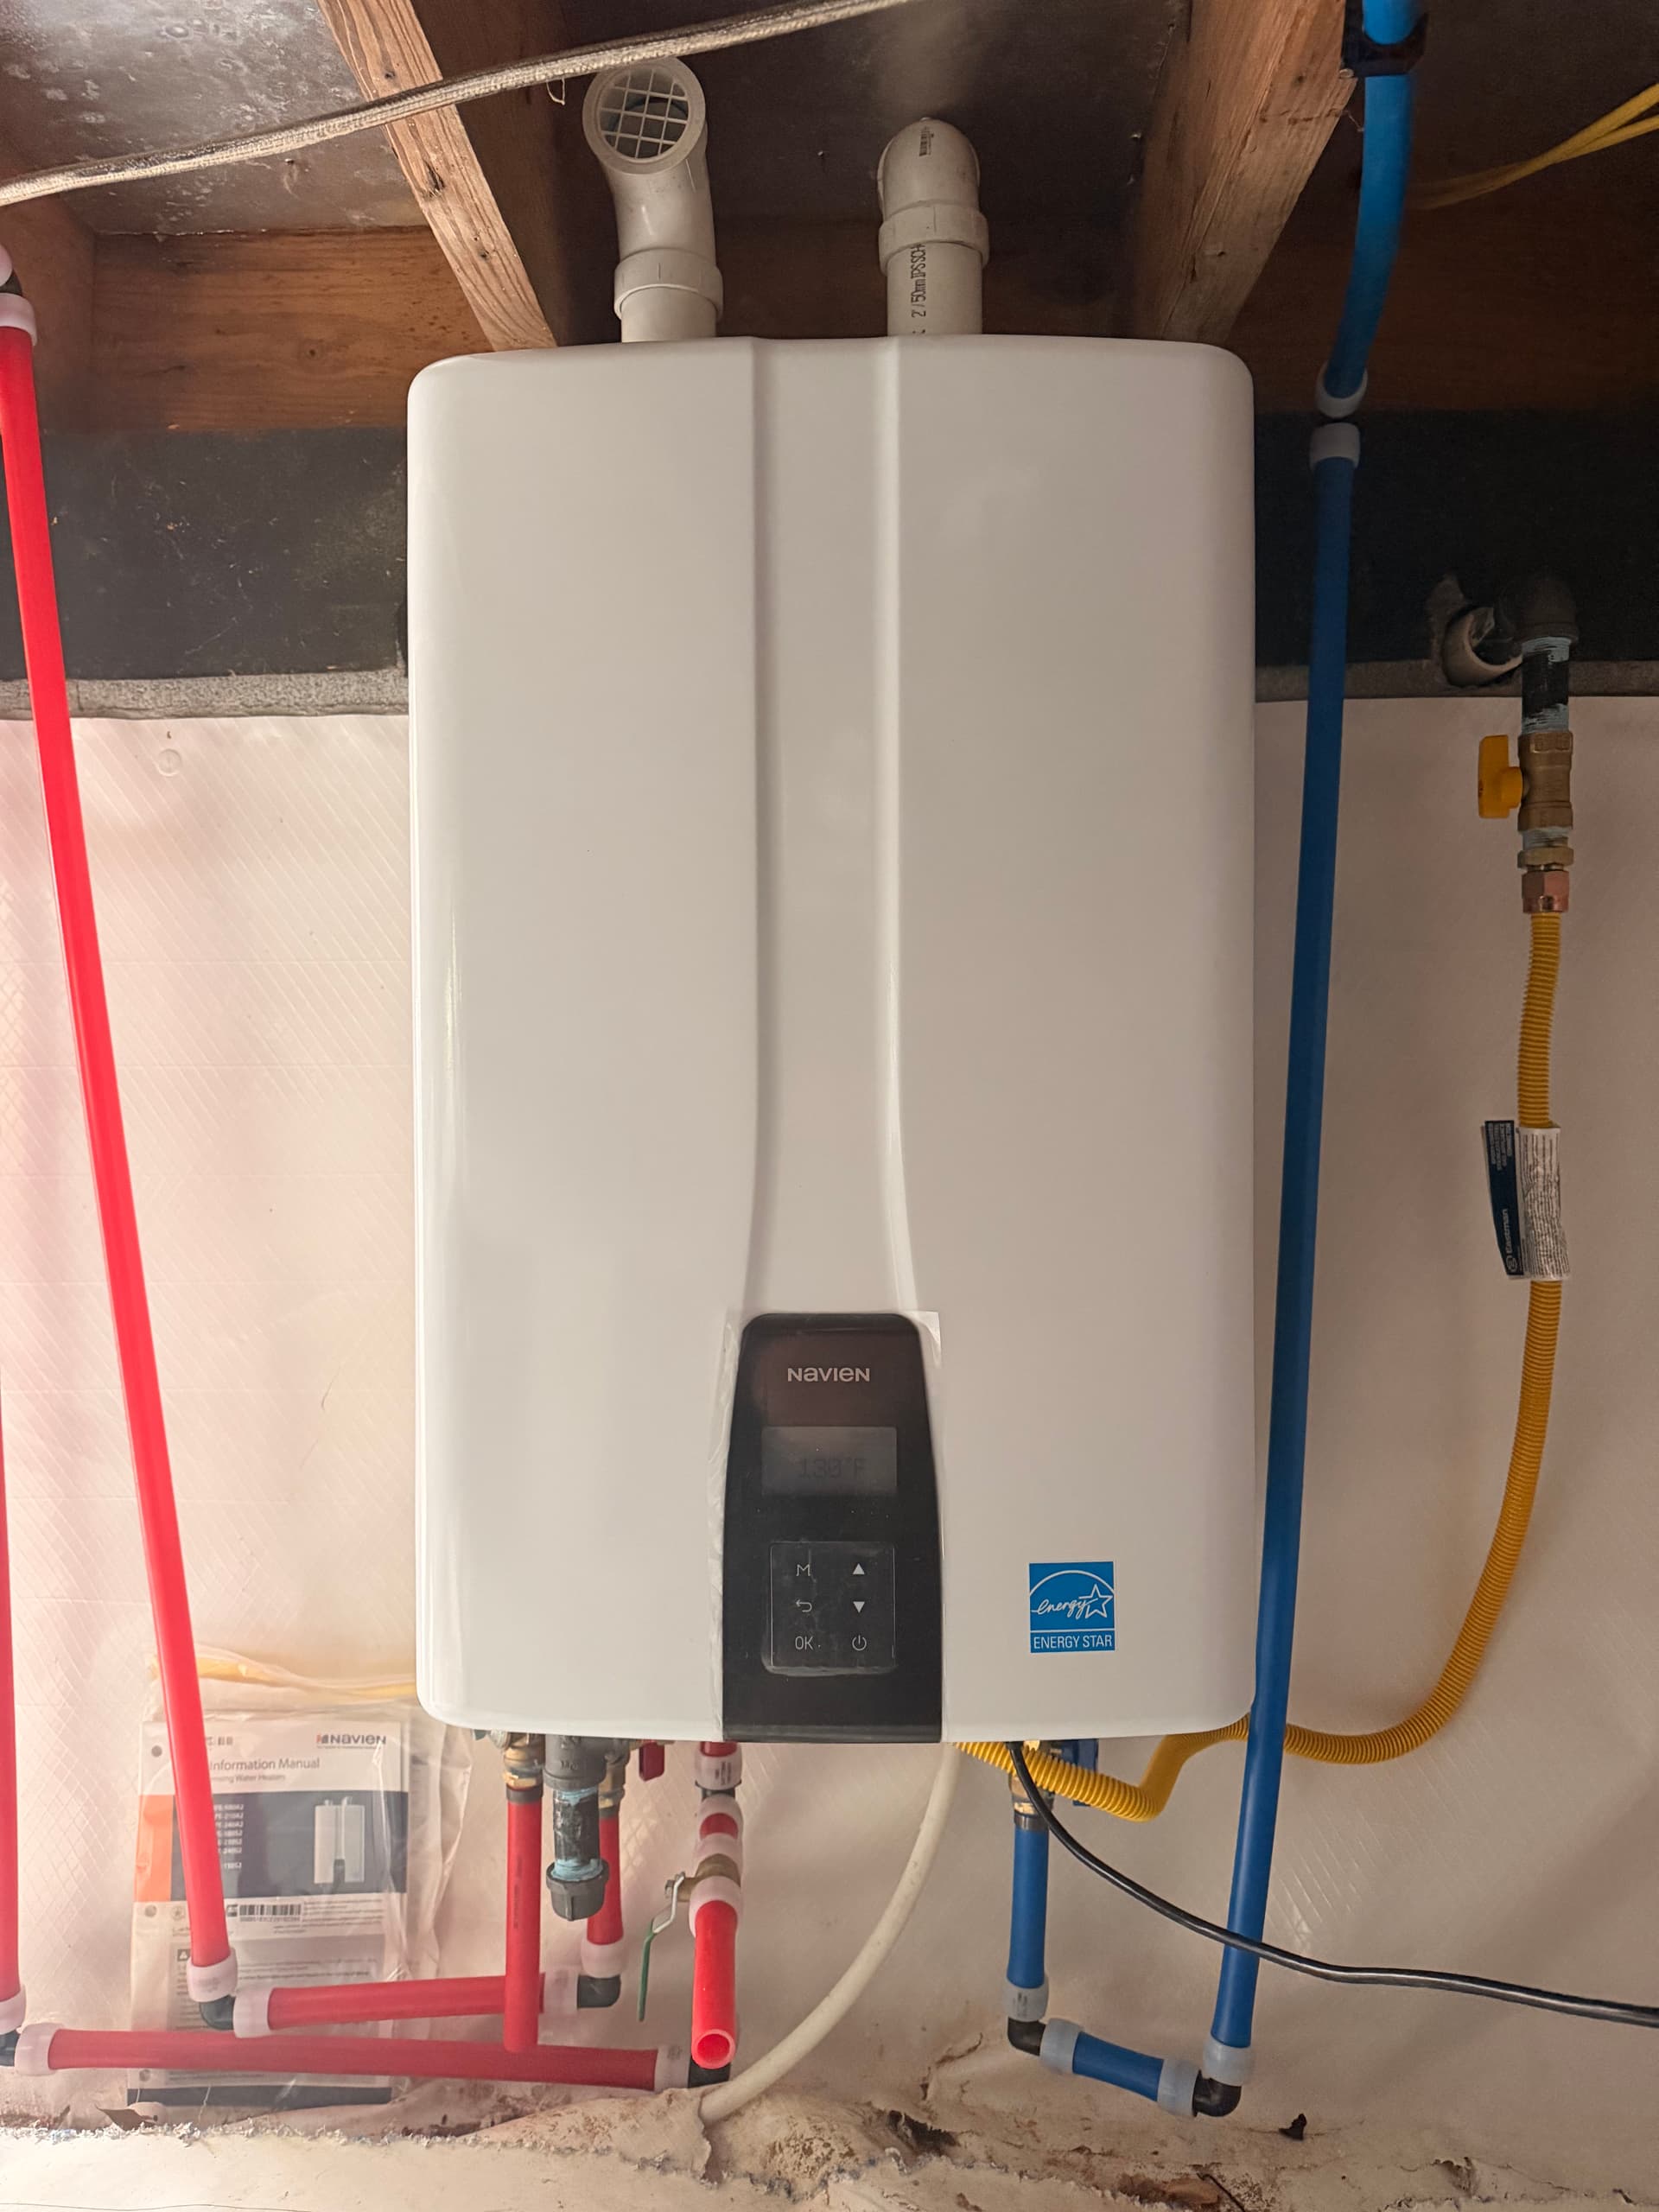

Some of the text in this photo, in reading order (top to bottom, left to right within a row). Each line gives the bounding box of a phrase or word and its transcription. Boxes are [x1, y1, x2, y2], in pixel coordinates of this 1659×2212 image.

[911, 279, 926, 303] 50mm
[796, 1564, 811, 1577] M
[795, 1636, 813, 1650] OK
[1033, 1634, 1113, 1649] ENERGY STAR
[278, 1758, 321, 1770] Manual
